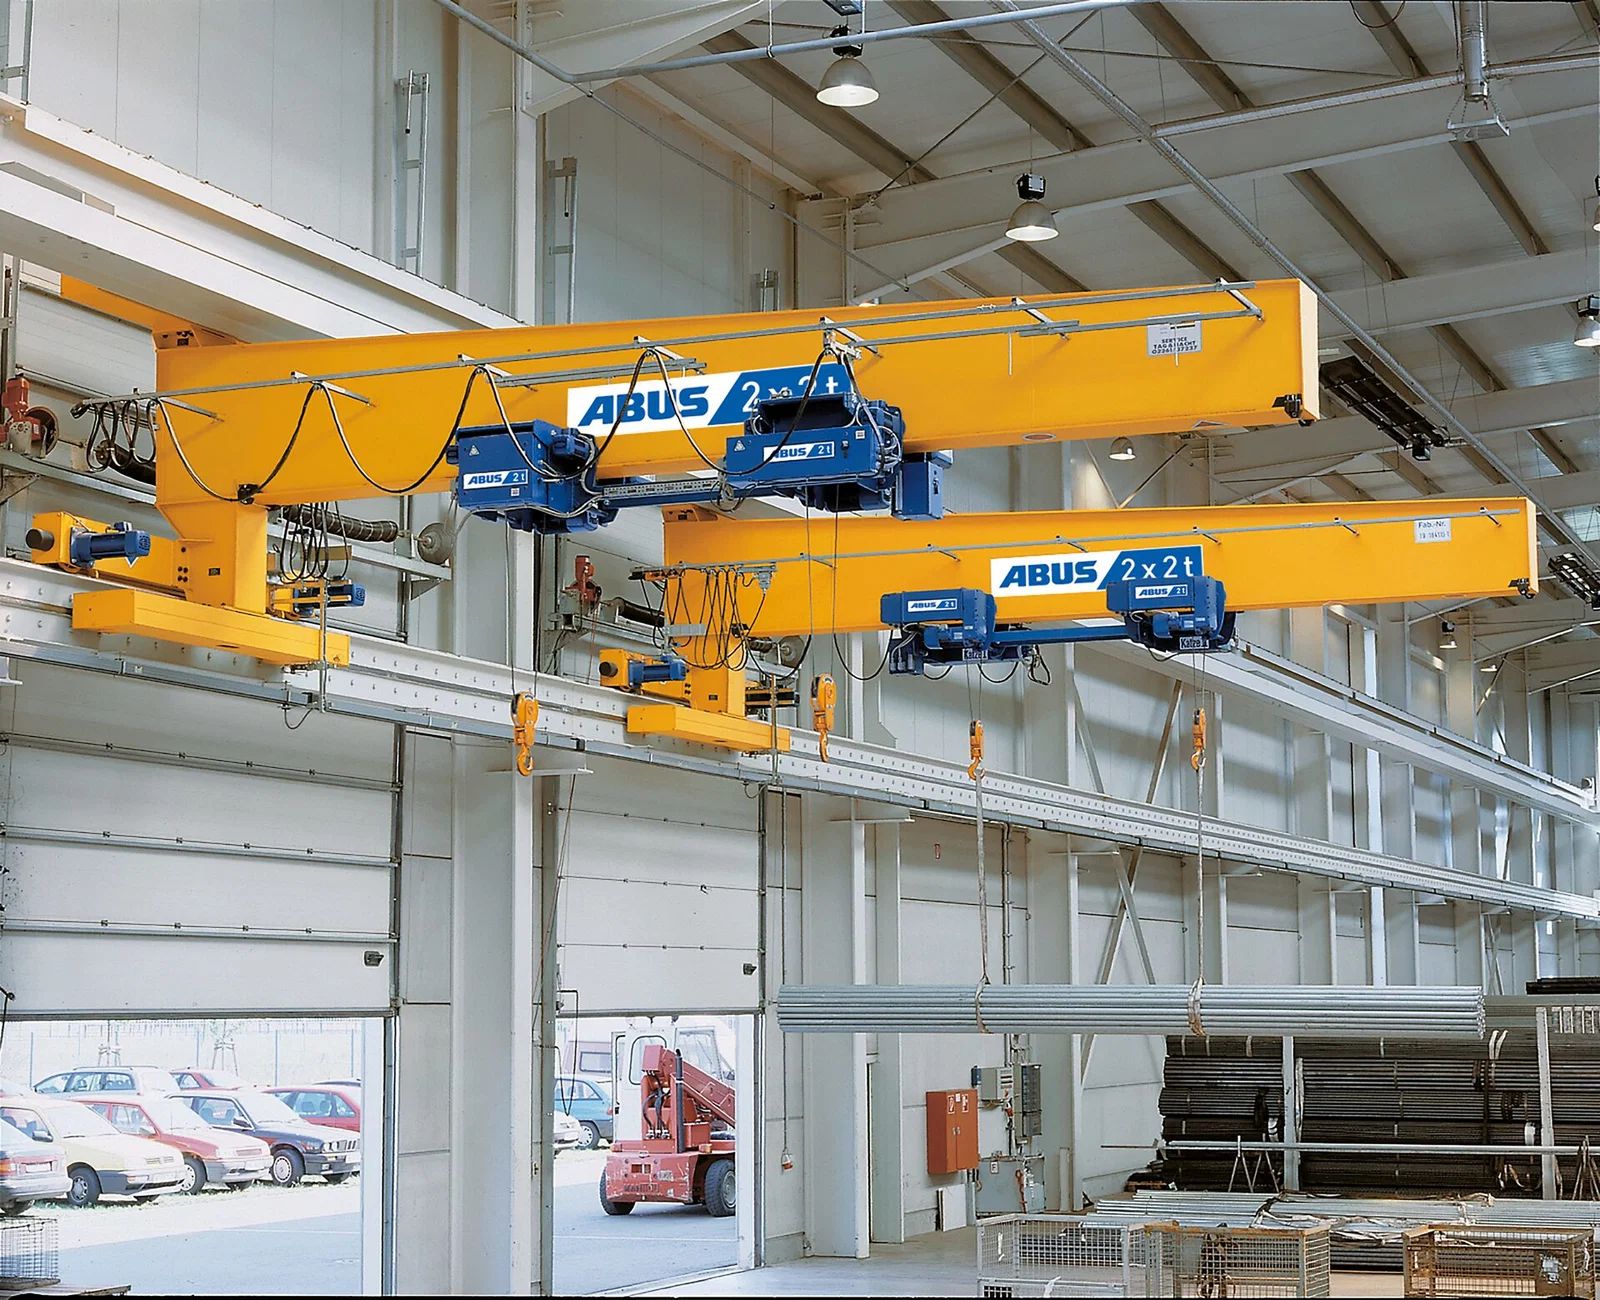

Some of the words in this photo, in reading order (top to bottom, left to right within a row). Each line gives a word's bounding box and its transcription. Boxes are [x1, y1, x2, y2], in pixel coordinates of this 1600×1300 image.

[578, 386, 709, 427] ABUS
[774, 447, 807, 458] BUS
[468, 474, 502, 485] ABUS
[999, 560, 1098, 588] ABUS
[1138, 588, 1168, 596] ABUS
